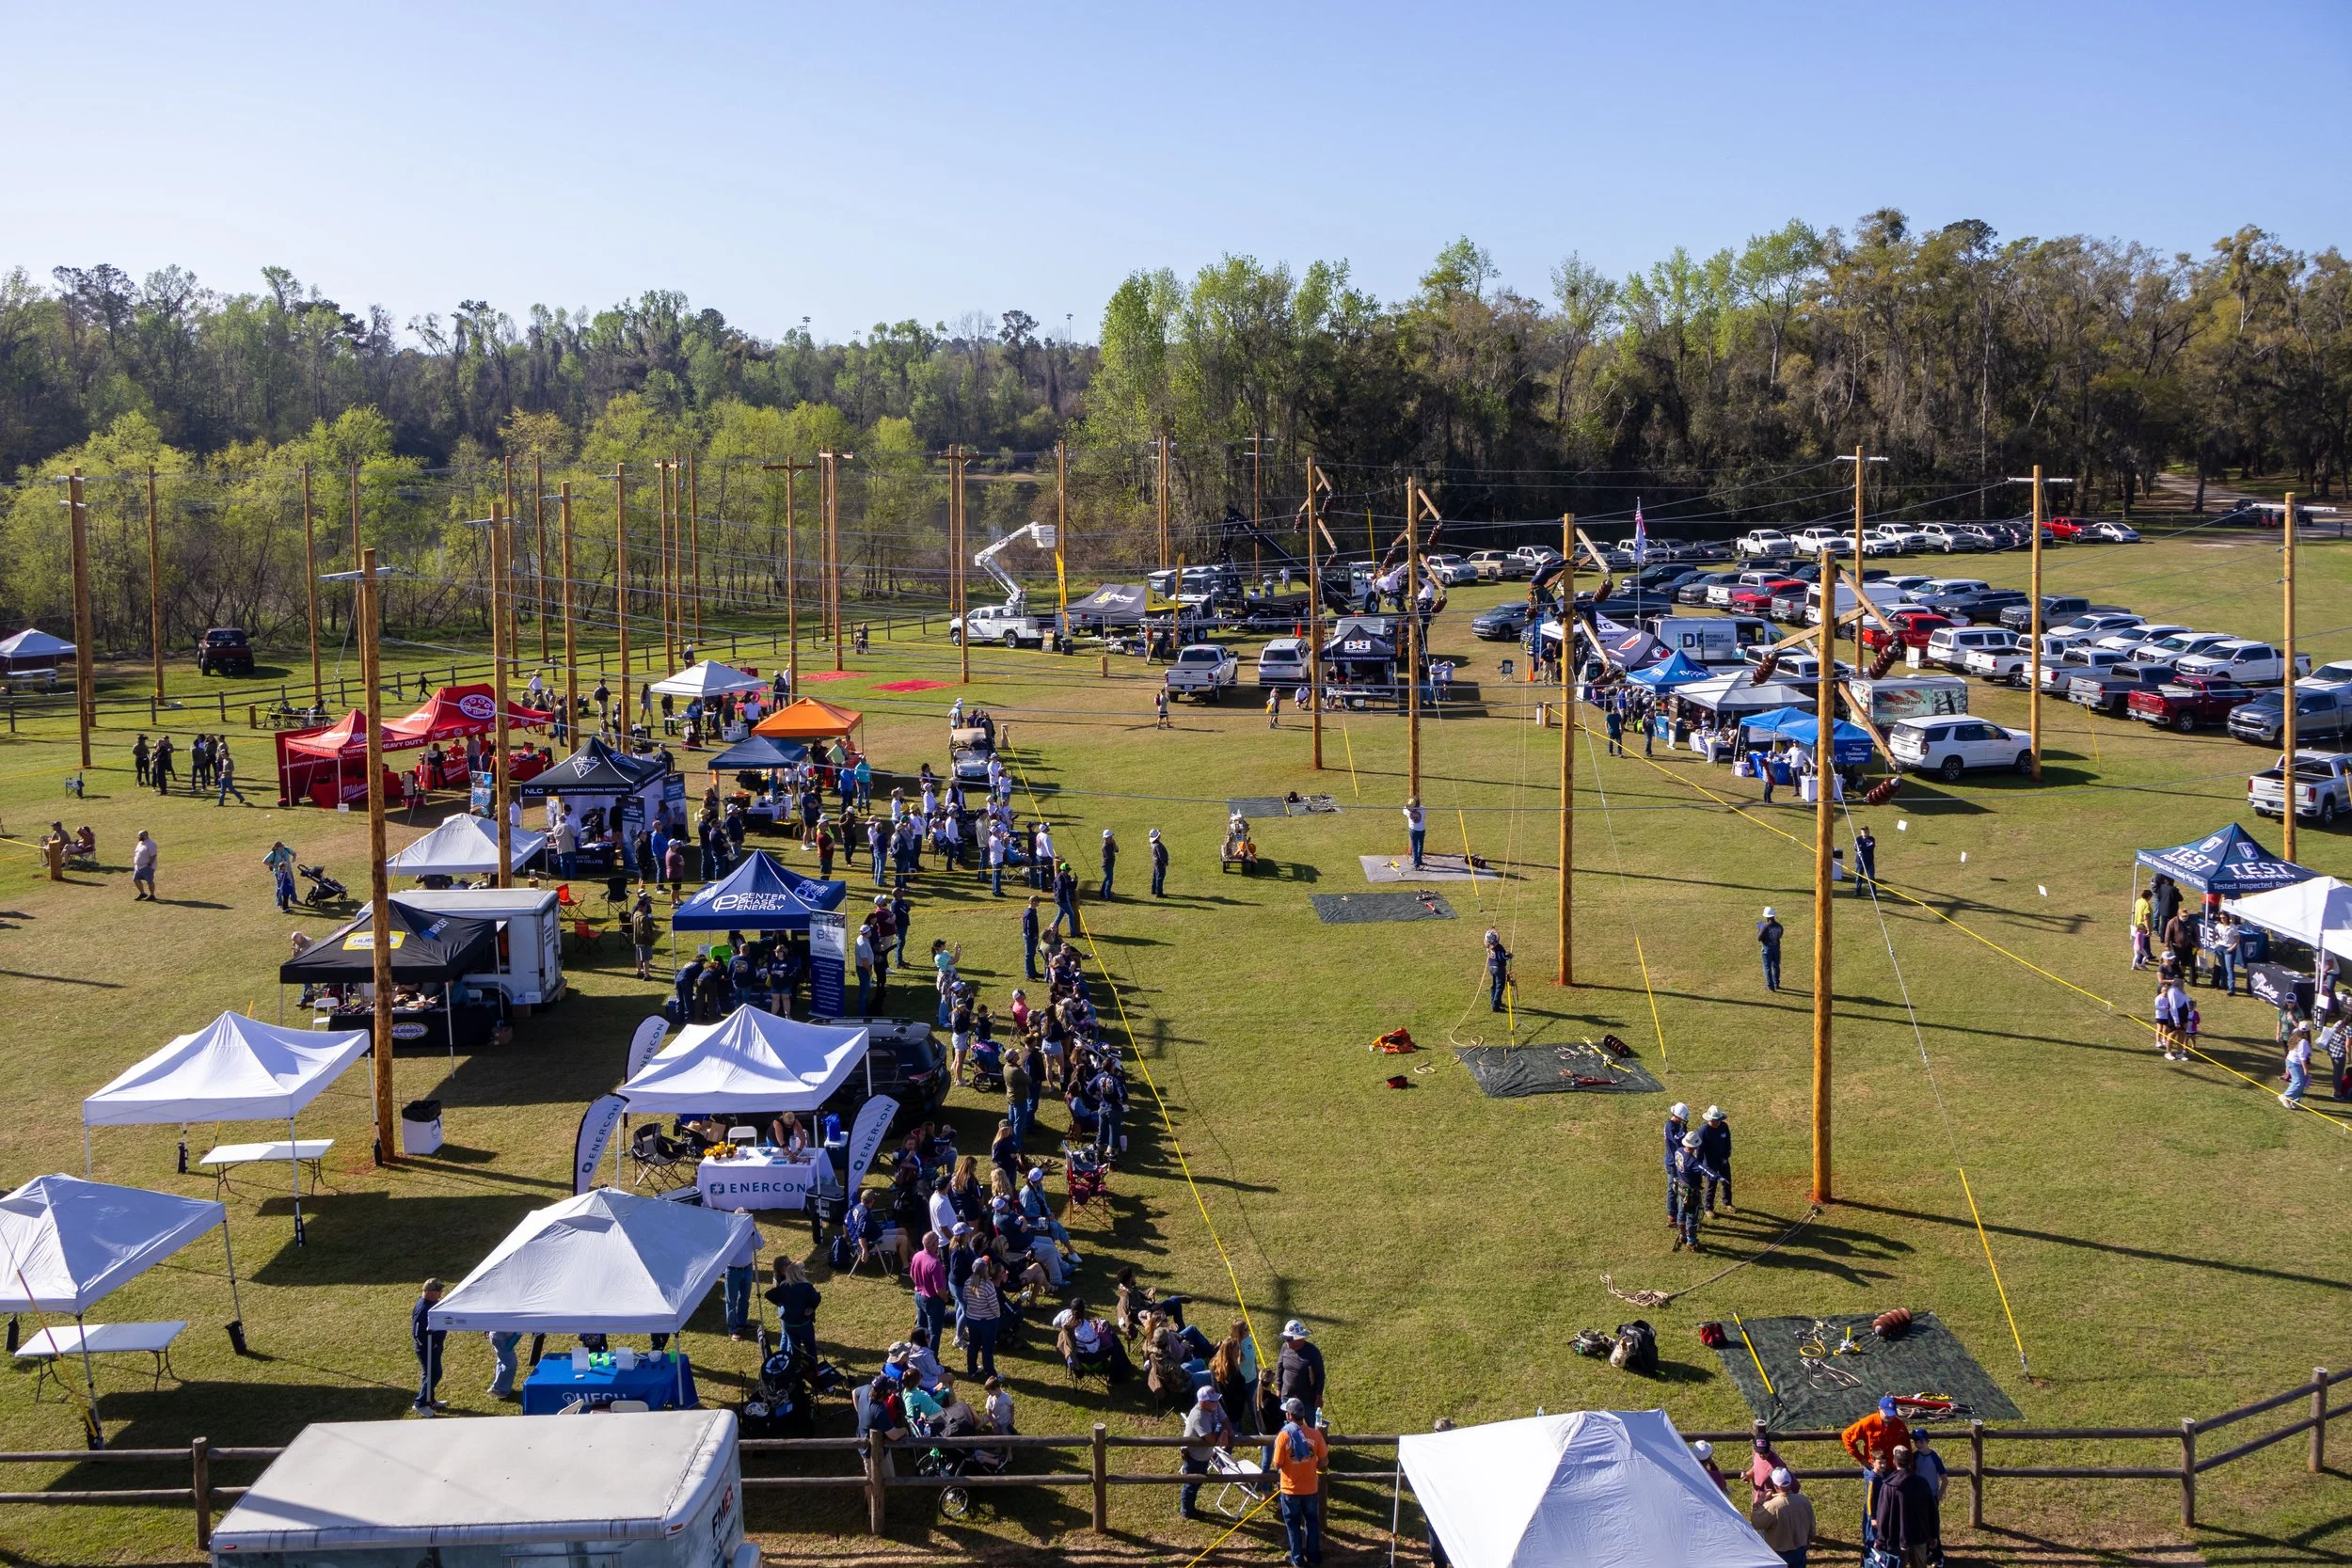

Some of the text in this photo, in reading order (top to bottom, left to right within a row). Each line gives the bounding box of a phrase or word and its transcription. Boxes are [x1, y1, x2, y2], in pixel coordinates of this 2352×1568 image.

[2169, 847, 2217, 869] TEST
[2225, 863, 2289, 875] TEST
[739, 893, 787, 901] CENTER
[637, 1023, 664, 1073] NERCON
[588, 1103, 620, 1160] ENERCON
[860, 1103, 893, 1158] ENERCON
[729, 1182, 806, 1194] ENERCON
